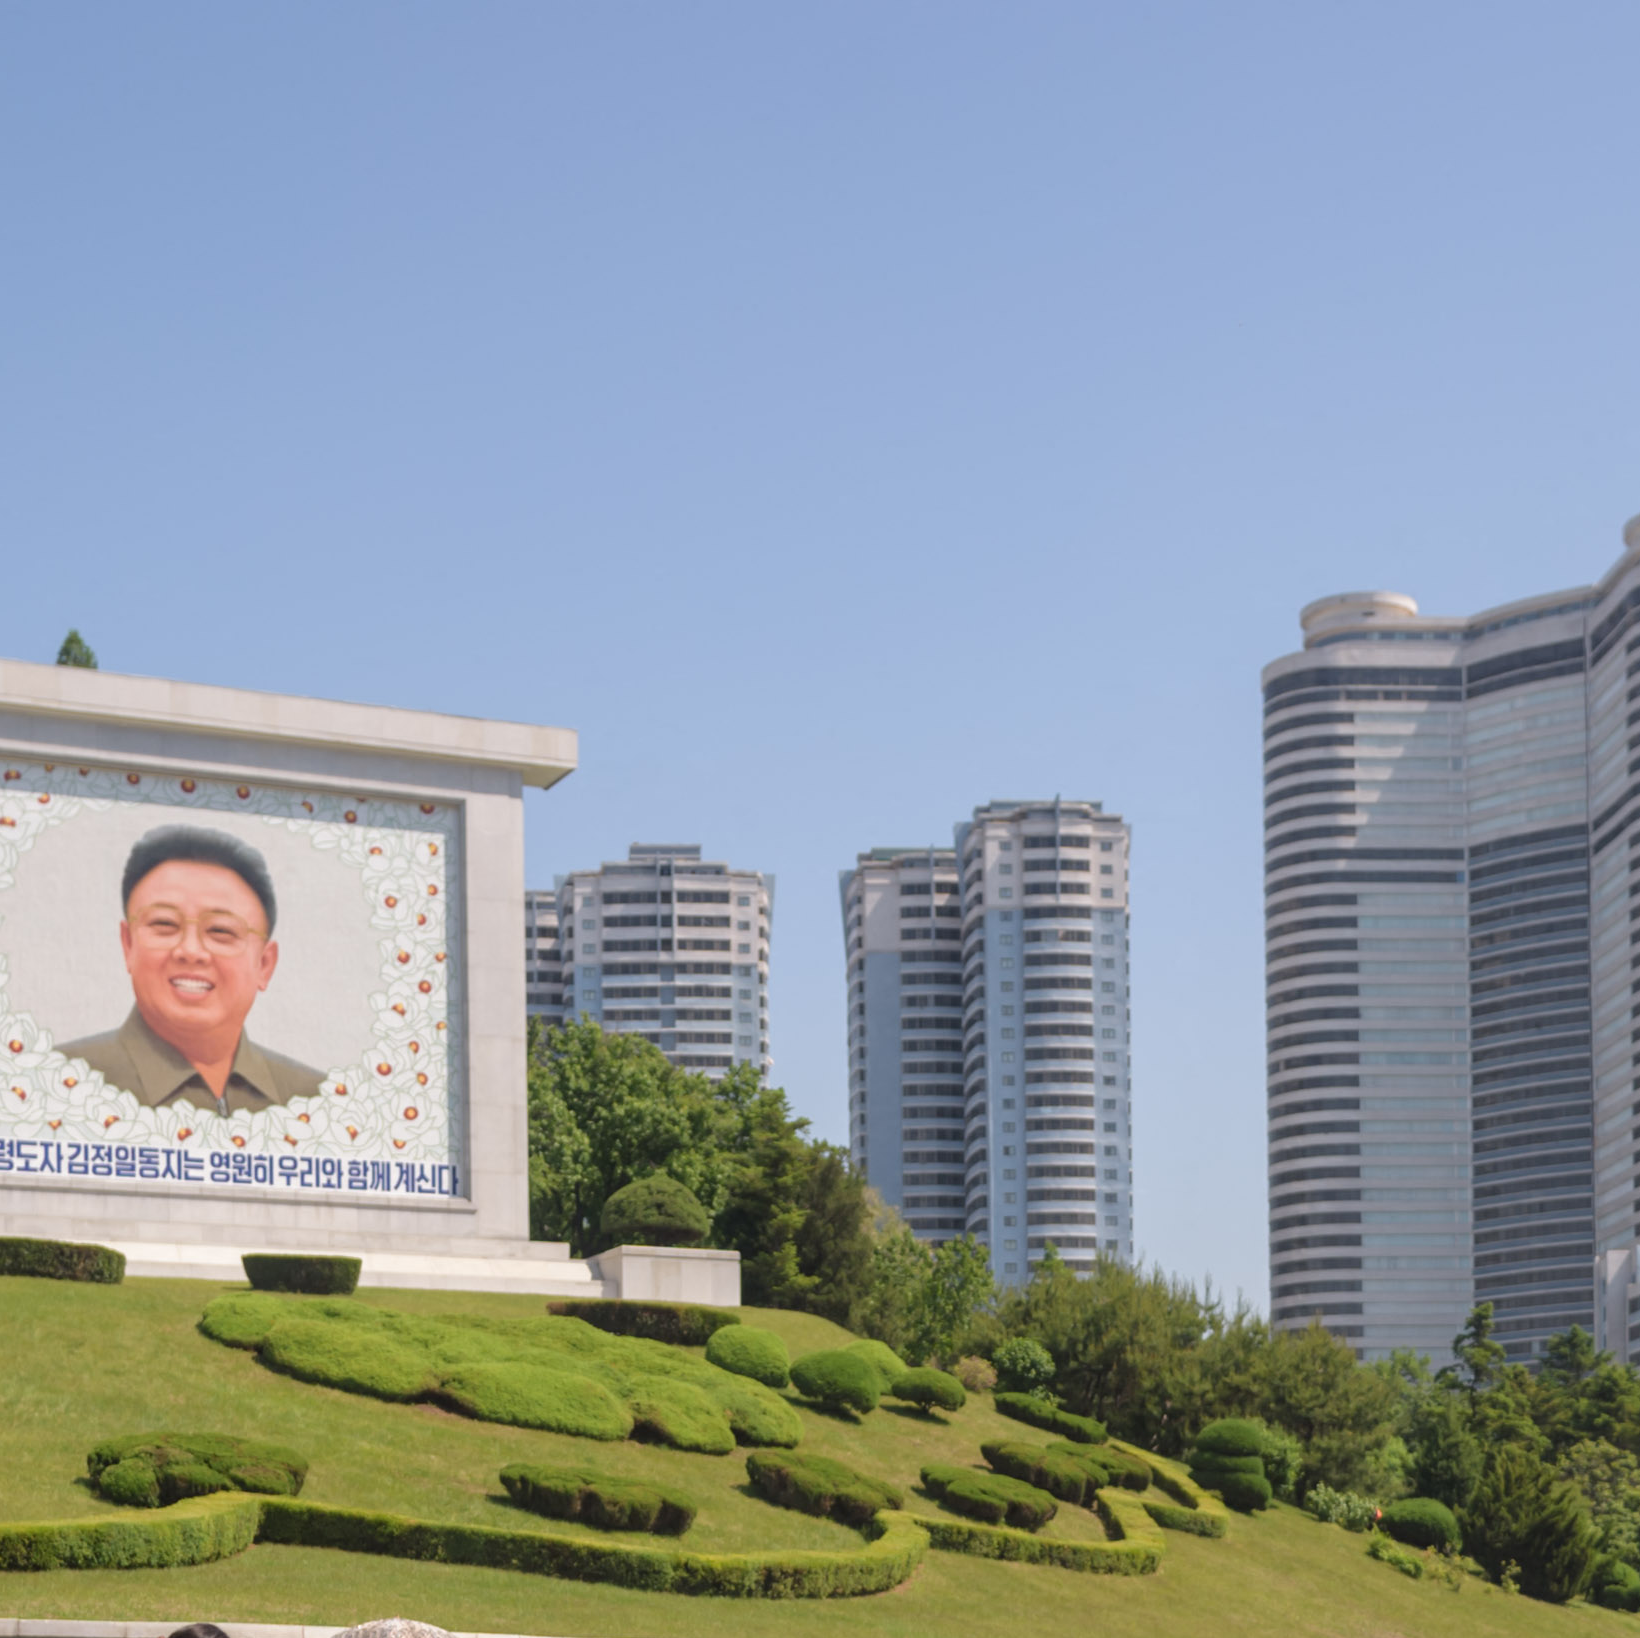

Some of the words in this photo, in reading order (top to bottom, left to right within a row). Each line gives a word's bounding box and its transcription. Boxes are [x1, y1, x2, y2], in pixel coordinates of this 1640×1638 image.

[67, 1143, 205, 1181] 김정일동지는
[210, 1151, 274, 1185] 영원히
[278, 1155, 344, 1189] 우리와
[348, 1160, 391, 1192] 함께
[394, 1163, 458, 1195] 계신다
